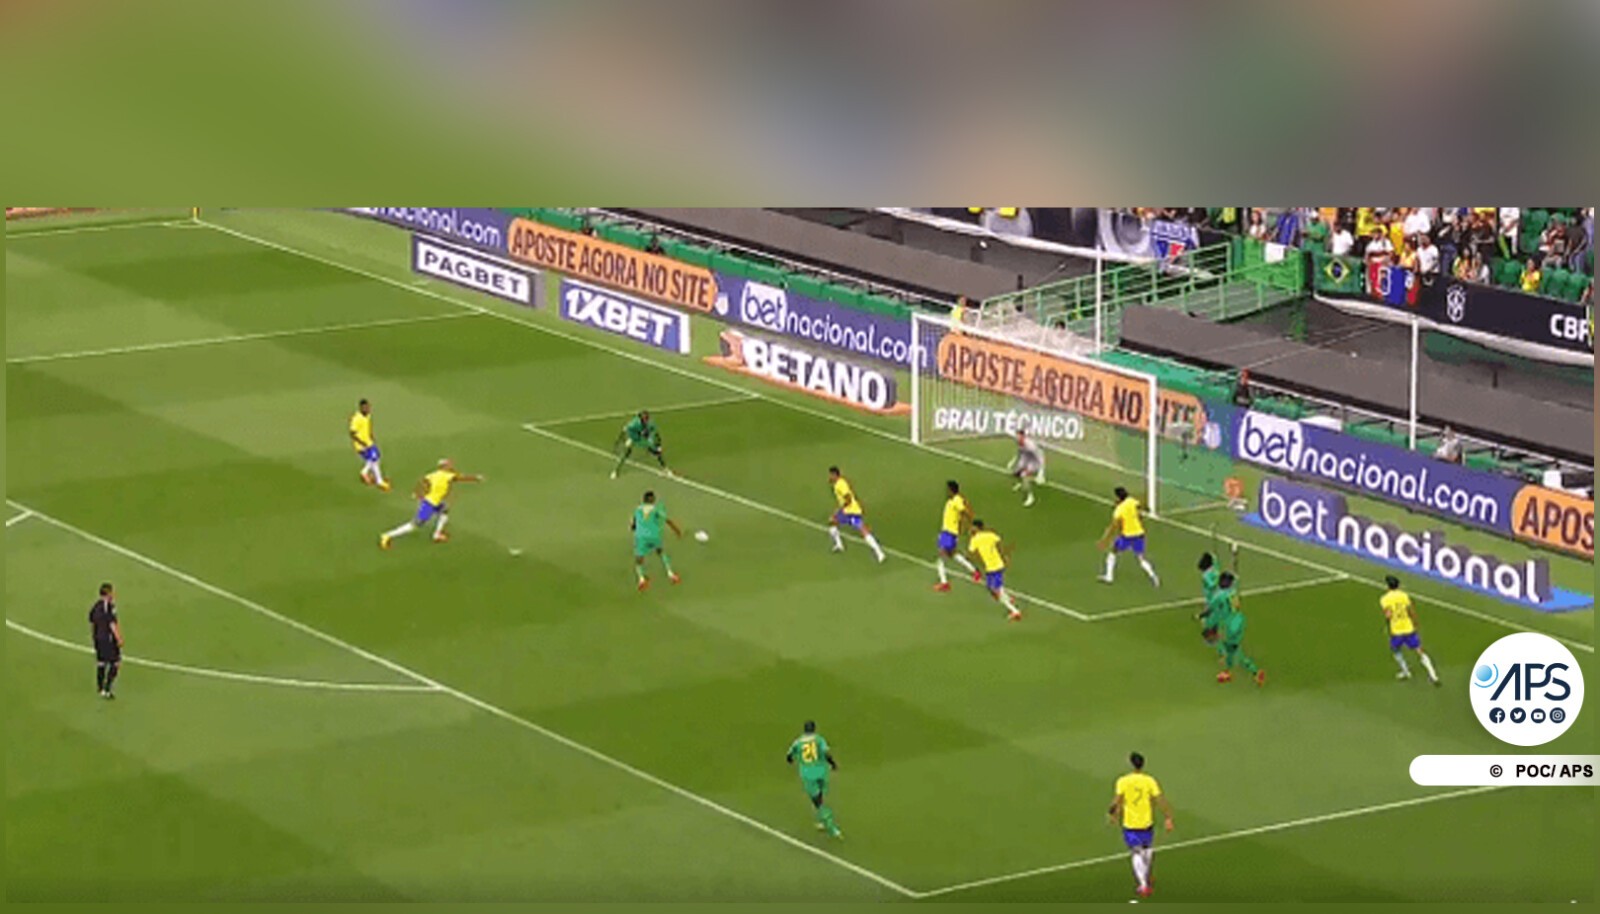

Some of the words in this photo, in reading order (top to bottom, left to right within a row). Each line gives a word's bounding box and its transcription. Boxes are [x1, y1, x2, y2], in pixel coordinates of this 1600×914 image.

[424, 251, 523, 294] PAGBET
[512, 225, 577, 271] APOSTE
[579, 250, 638, 288] AGORA
[643, 266, 667, 300] NO
[671, 276, 710, 309] SITE
[565, 288, 672, 345] 1XBET
[745, 340, 888, 409] BETANO
[943, 343, 1026, 391] APOSTE
[1030, 367, 1105, 415] AGORA
[1112, 384, 1142, 425] NO
[935, 408, 988, 433] GRAU
[801, 740, 818, 764] 21
